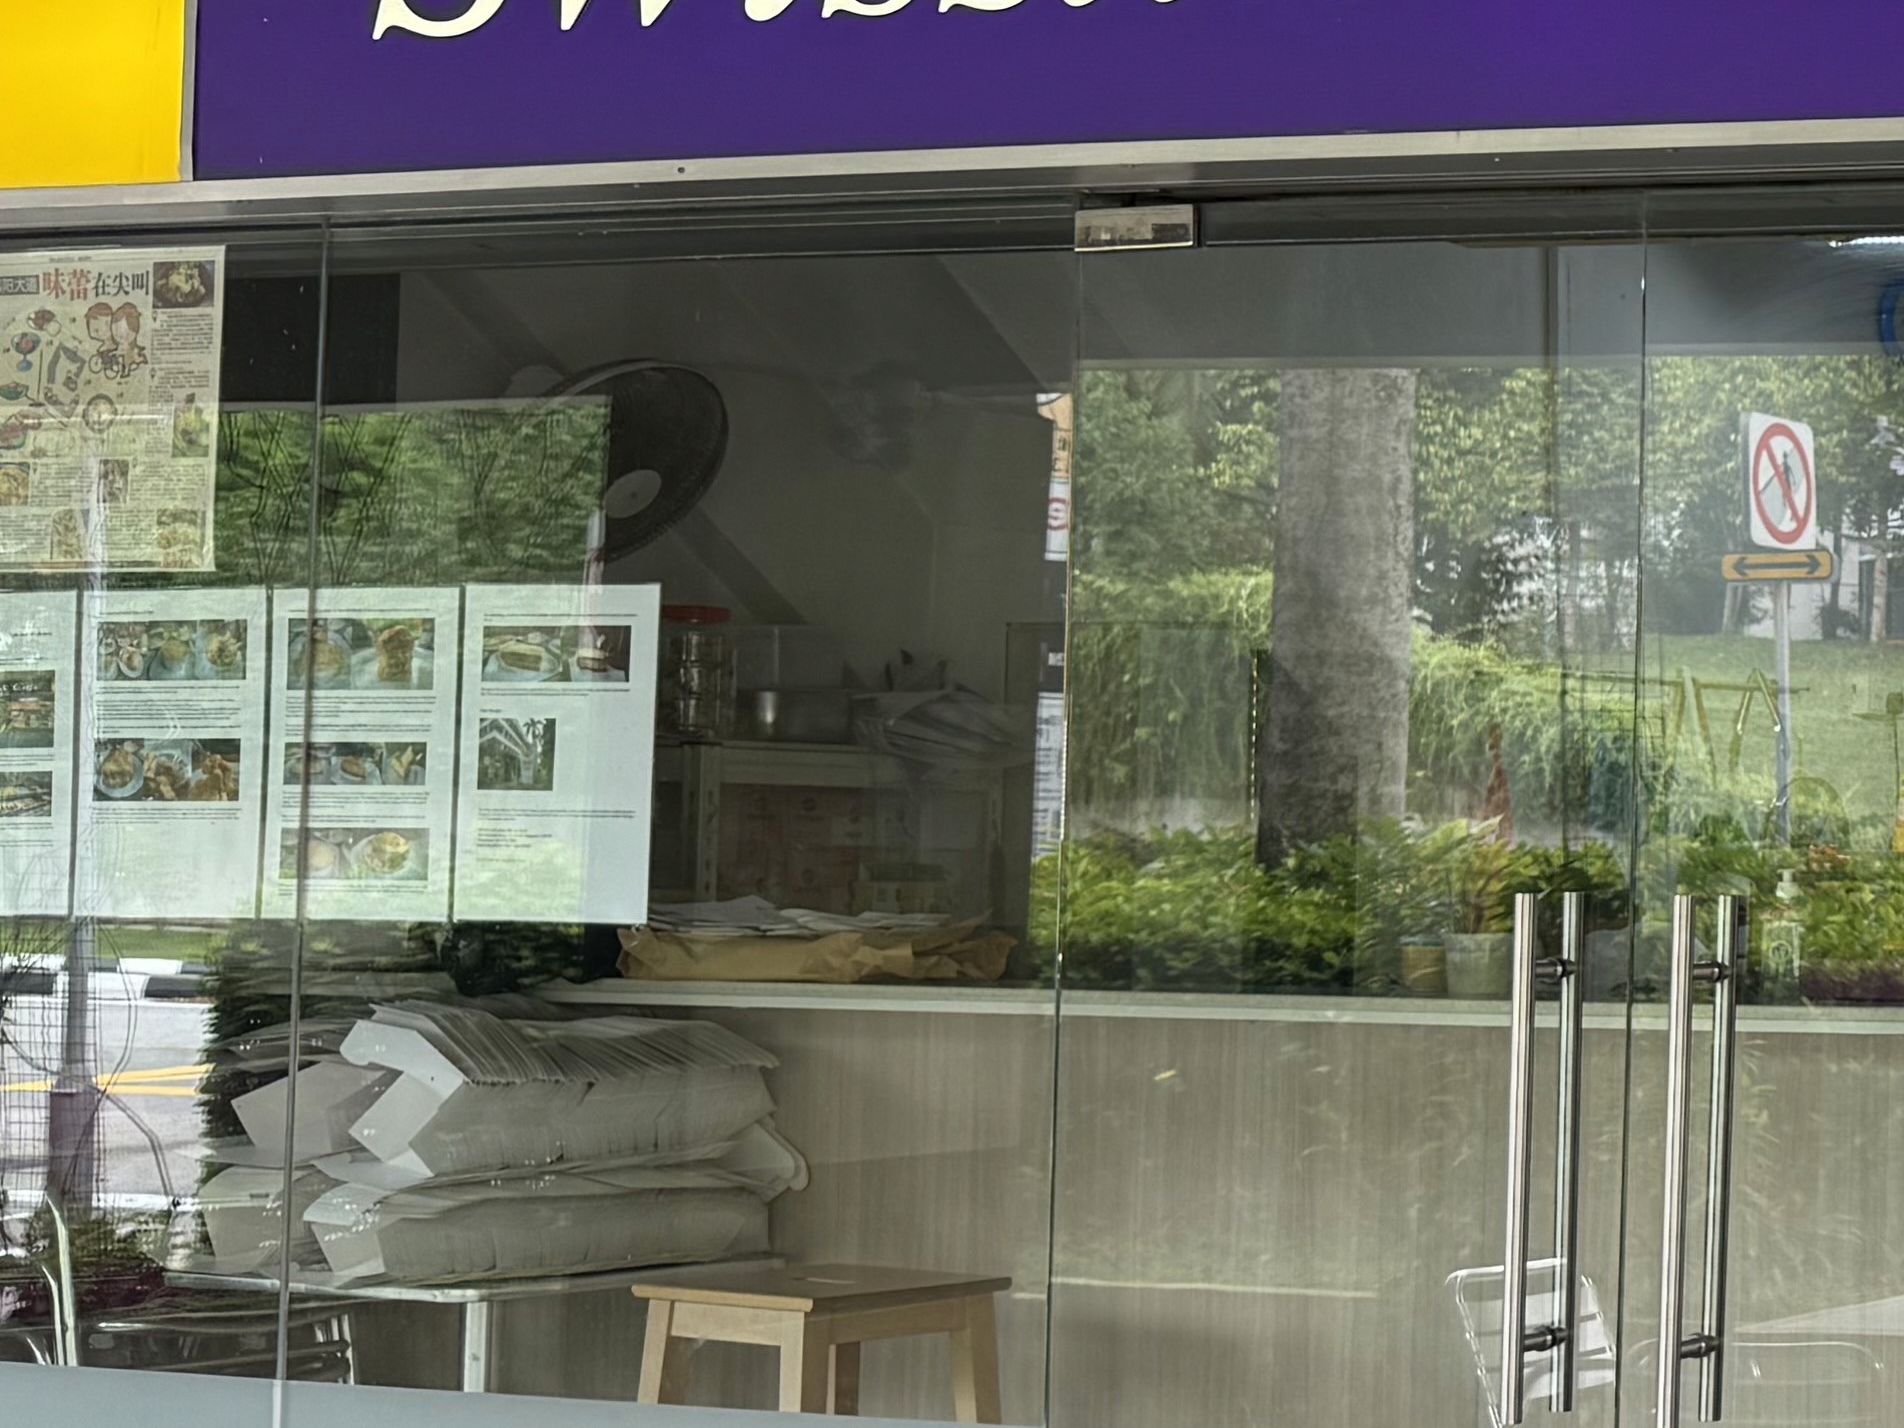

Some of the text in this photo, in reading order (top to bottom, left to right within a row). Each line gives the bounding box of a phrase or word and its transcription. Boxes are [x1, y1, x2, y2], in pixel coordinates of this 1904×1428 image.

[42, 268, 149, 301] 味蕾在尖叫
